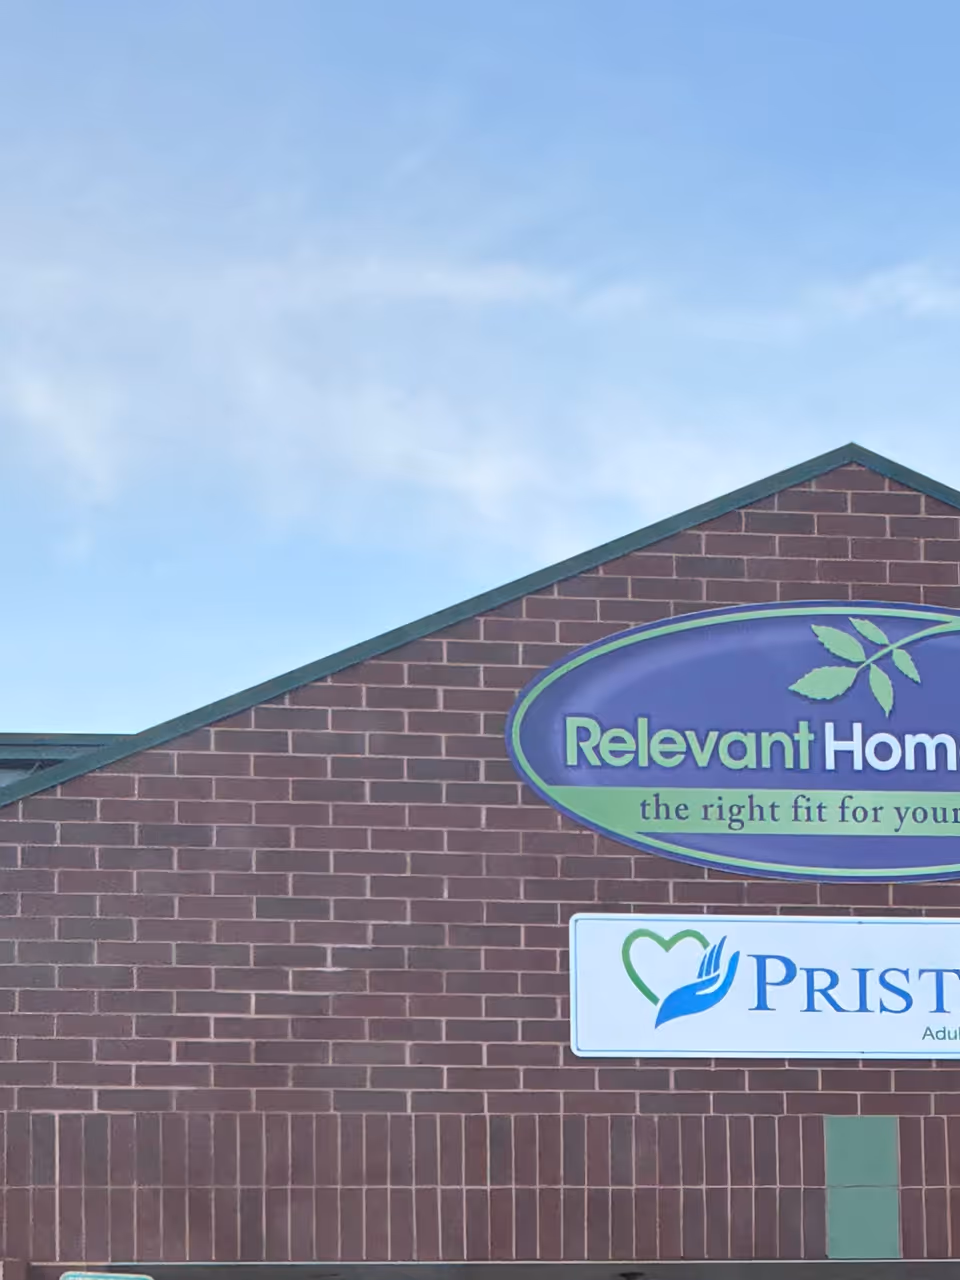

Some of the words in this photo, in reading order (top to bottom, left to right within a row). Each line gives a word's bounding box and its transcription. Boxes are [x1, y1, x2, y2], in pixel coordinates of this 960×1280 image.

[640, 793, 690, 821] the
[702, 794, 780, 831] right
[792, 795, 827, 823] fit
[838, 796, 884, 823] for
